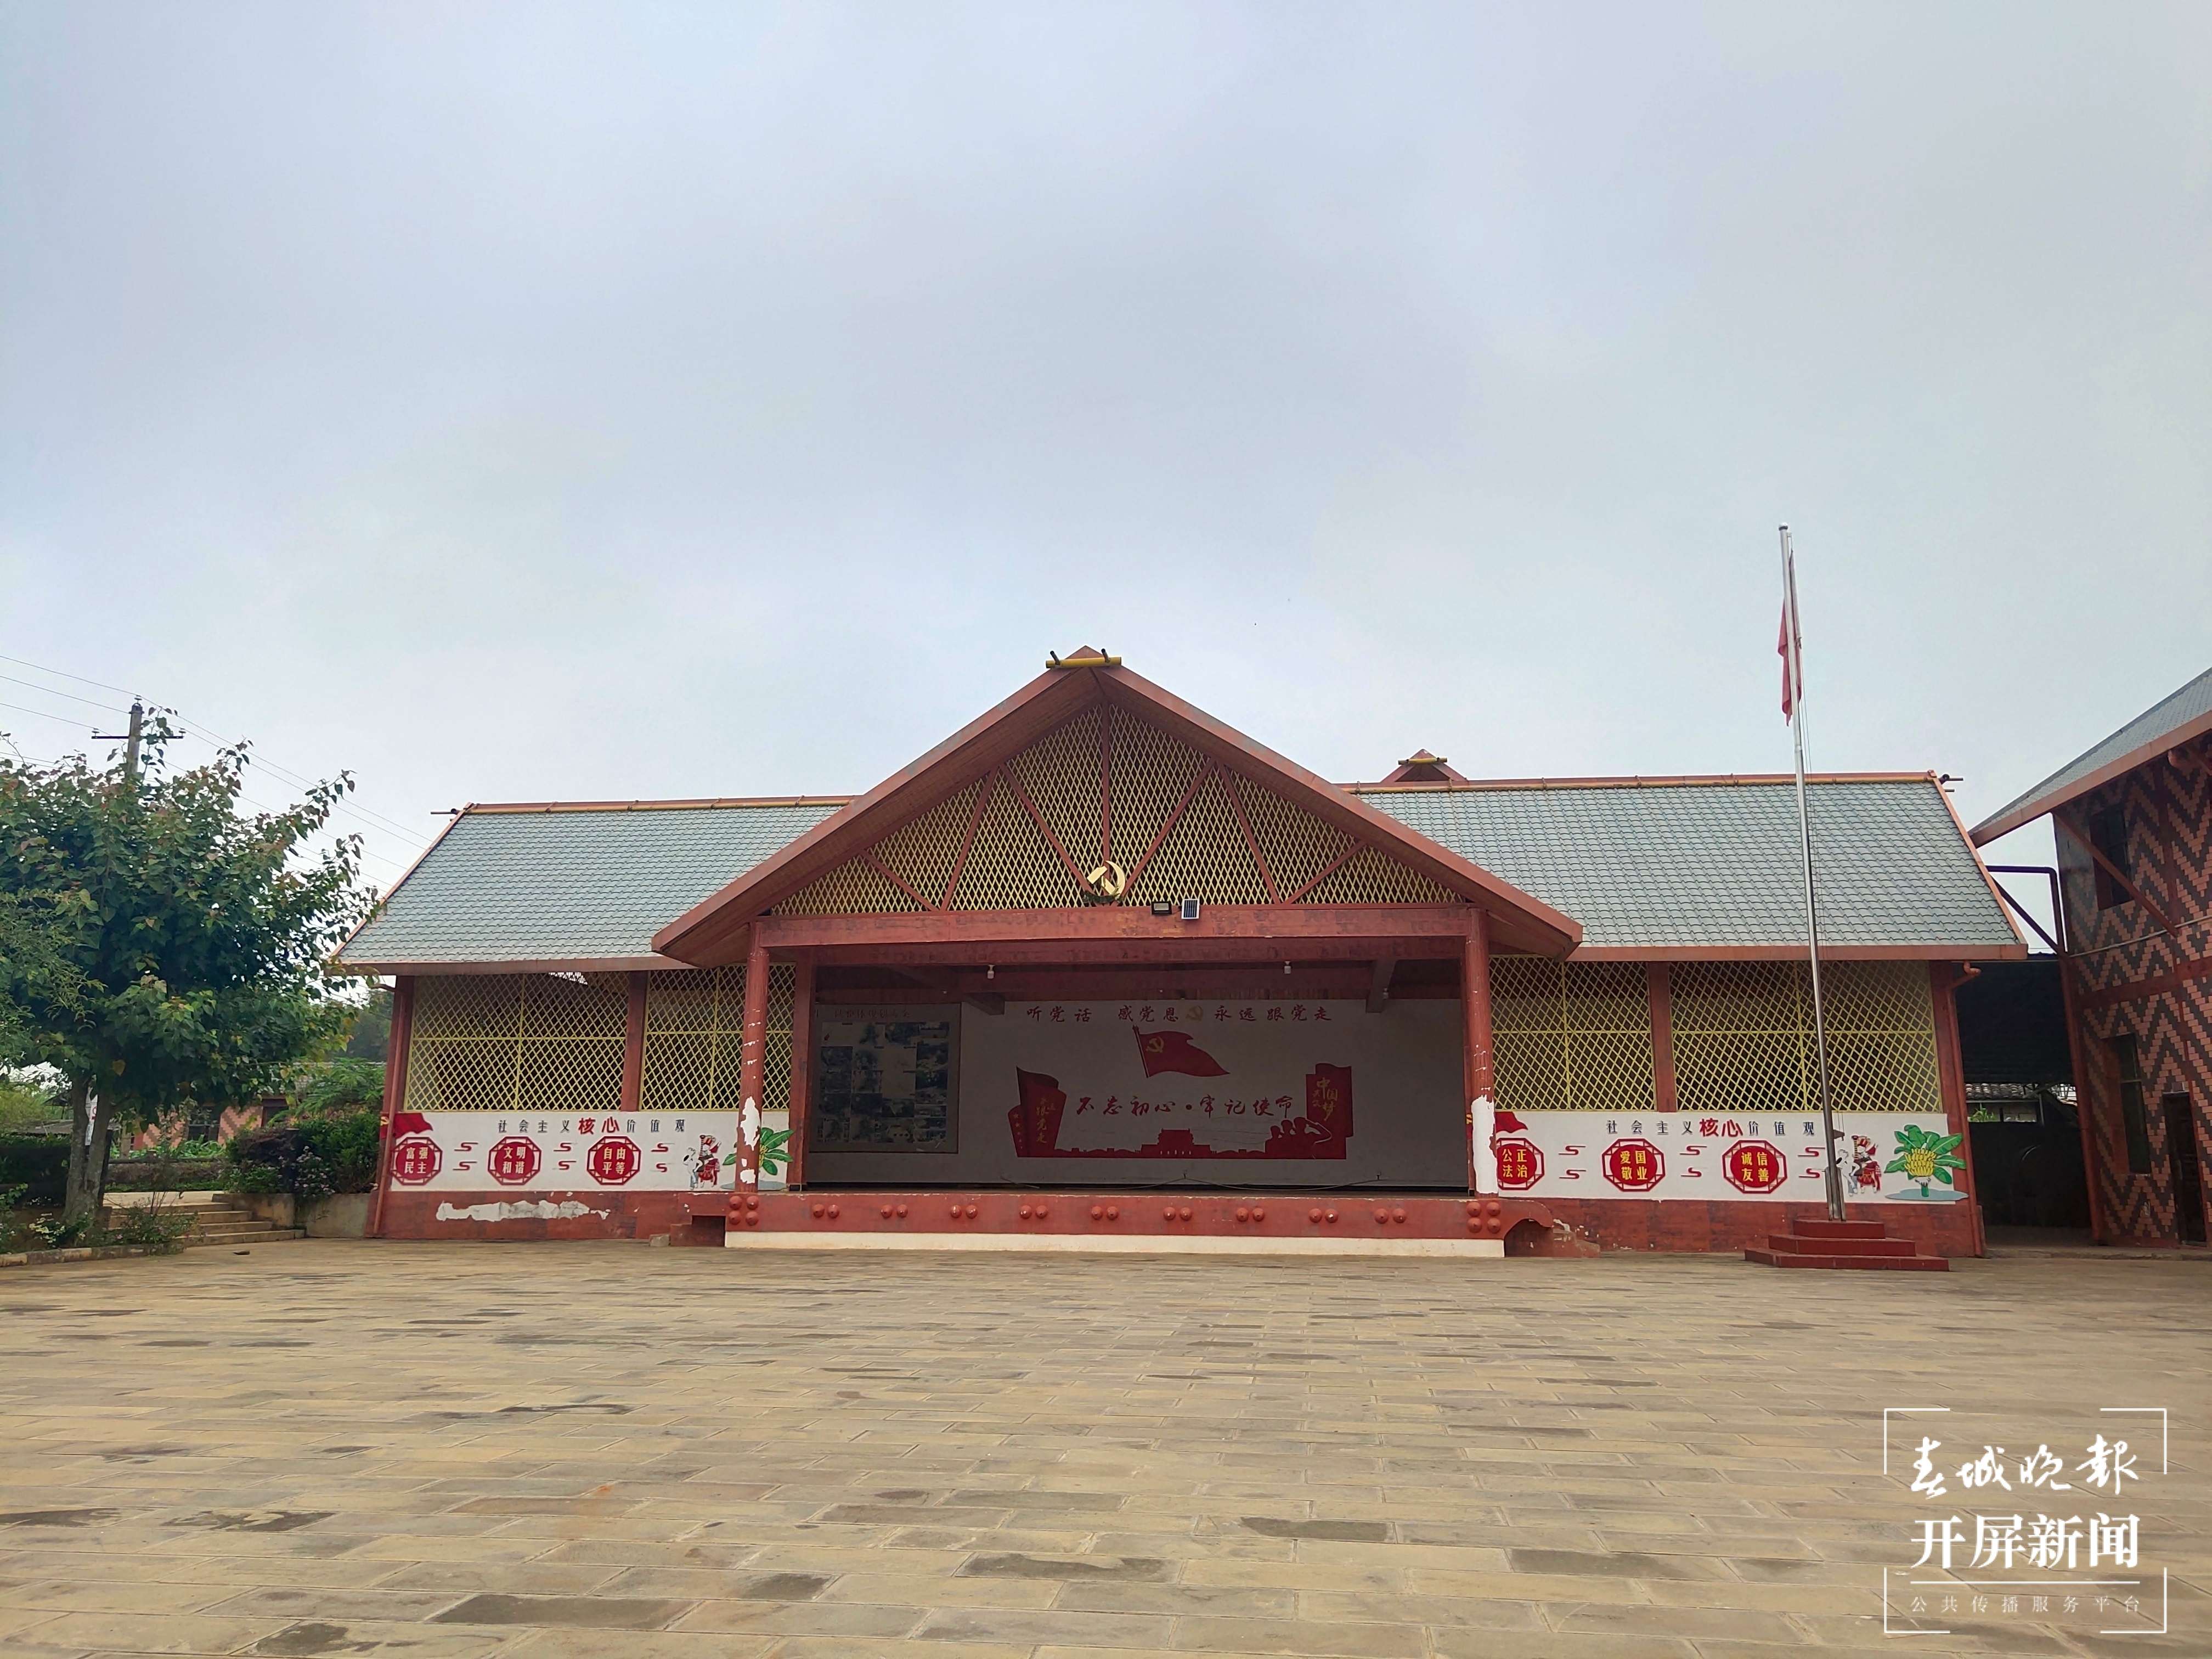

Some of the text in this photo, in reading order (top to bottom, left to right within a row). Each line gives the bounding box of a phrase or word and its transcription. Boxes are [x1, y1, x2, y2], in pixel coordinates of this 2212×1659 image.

[1027, 1005, 1331, 1022] 听党话 感党恩 永远跟党走
[498, 1116, 685, 1135] 社会主义核心价值观
[1606, 1118, 1814, 1137] 社会主义核心价值观
[406, 1147, 428, 1159] 富强
[504, 1147, 526, 1159] 文明
[603, 1147, 627, 1160] 自由
[1502, 1148, 1527, 1163] 公正
[1620, 1150, 1646, 1164] 爱国
[1741, 1152, 1768, 1166] 诚信
[404, 1161, 427, 1173] 民主
[503, 1161, 524, 1174] 和谐
[602, 1162, 625, 1175] 平等
[1503, 1165, 1527, 1178] 法治
[1621, 1166, 1648, 1180] 敬业
[1742, 1168, 1769, 1182] 友善
